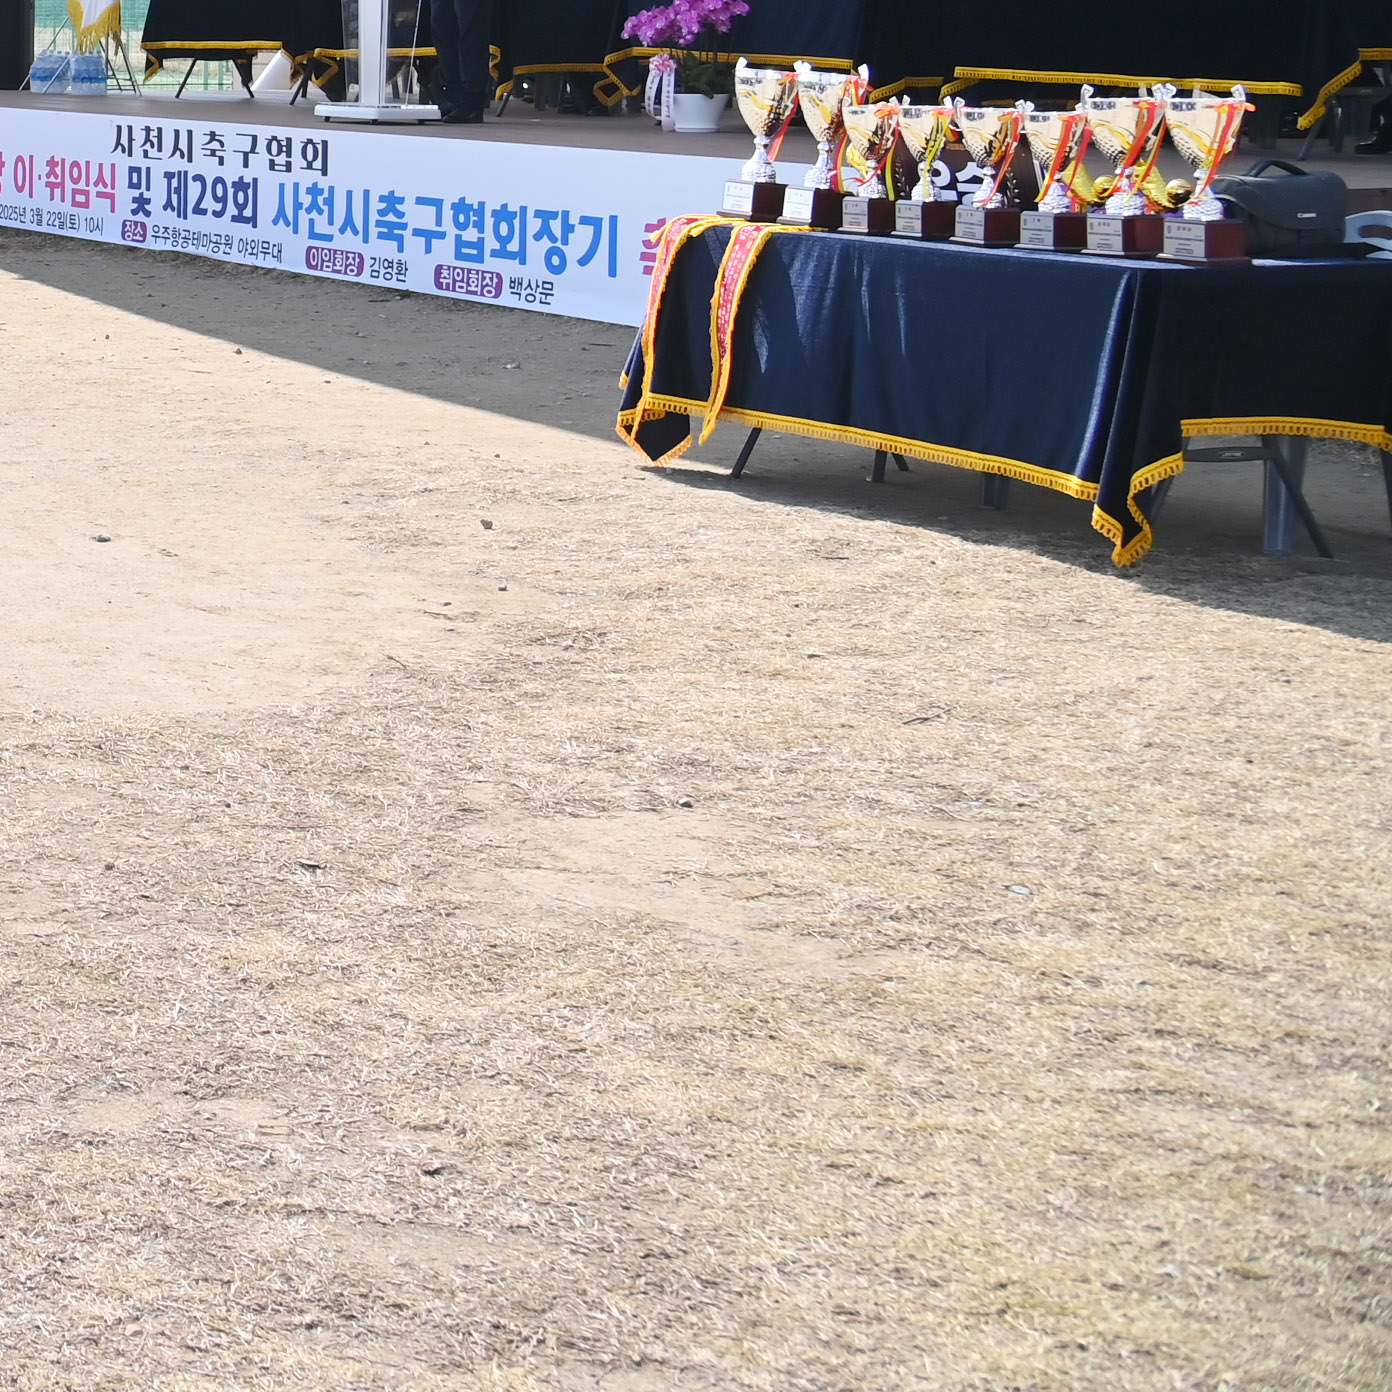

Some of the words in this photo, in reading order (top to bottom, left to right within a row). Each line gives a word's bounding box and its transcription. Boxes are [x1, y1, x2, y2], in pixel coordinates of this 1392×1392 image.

[111, 124, 329, 177] 사천시축구협회
[0, 205, 27, 223] 2025년
[29, 209, 43, 225] 3월
[46, 212, 80, 233] 22일(토)
[84, 217, 104, 236] 10시
[123, 221, 145, 242] 장소
[151, 224, 234, 256] 우주항공테마공원
[237, 235, 283, 264] 야외무대
[309, 248, 362, 276] 이임회장
[369, 255, 409, 284] 김영환
[439, 267, 498, 298] 취임회장
[509, 276, 555, 305] 백상문
[14, 154, 117, 214] 이·취임식
[127, 166, 152, 218] 및
[162, 170, 258, 229] 제29회
[271, 179, 618, 279] 사천시축구협회장기
